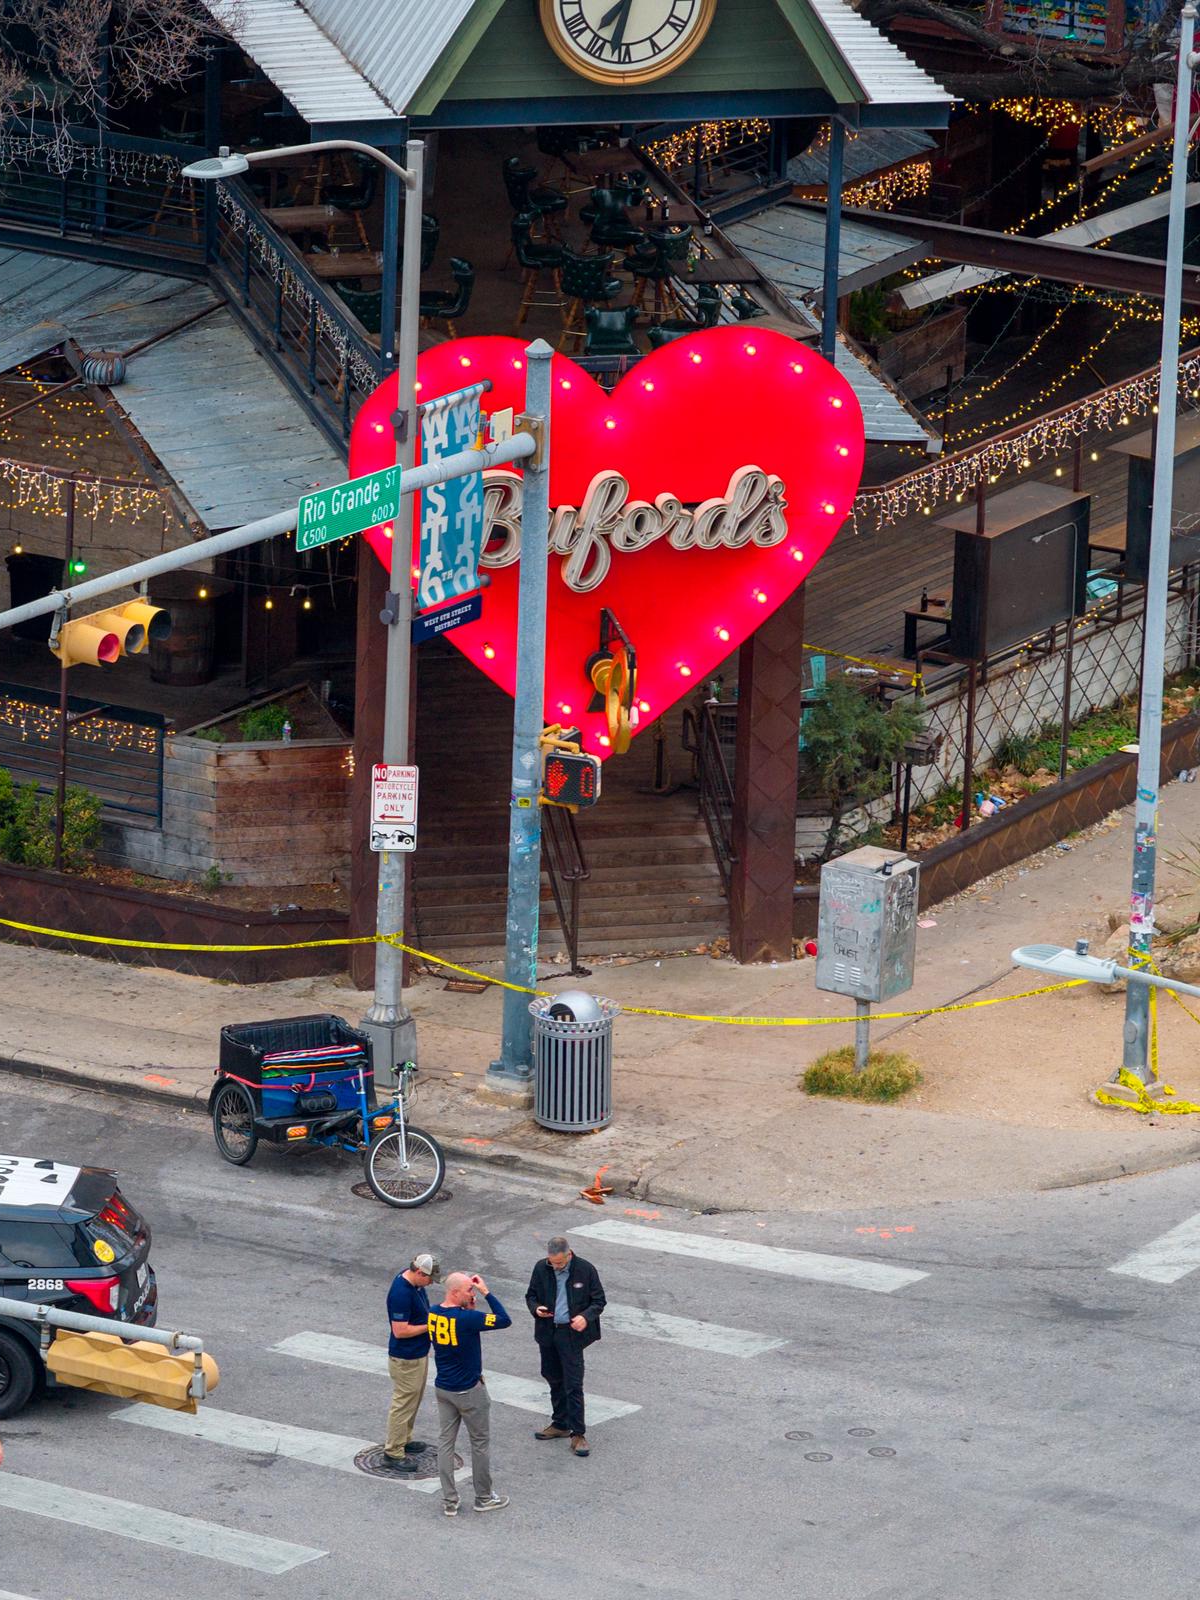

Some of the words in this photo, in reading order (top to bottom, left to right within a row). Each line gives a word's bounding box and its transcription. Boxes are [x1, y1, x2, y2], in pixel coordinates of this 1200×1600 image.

[303, 497, 326, 525] Rio
[331, 479, 380, 515] Grande
[385, 469, 397, 489] ST
[309, 526, 327, 545] 500
[371, 504, 388, 523] 600
[481, 464, 789, 593] Buford's
[424, 616, 439, 628] WEST
[440, 612, 451, 622] 6TH
[451, 604, 472, 618] STREET
[434, 617, 461, 633] DISTRICT
[374, 767, 387, 780] NO
[388, 770, 415, 778] PARKING
[376, 783, 415, 791] MOTORCYCLE
[377, 792, 413, 801] PARKING
[384, 803, 405, 812] ONLY
[27, 1278, 64, 1291] 2868
[484, 1313, 497, 1327] FBI
[427, 1312, 458, 1346] FBI
